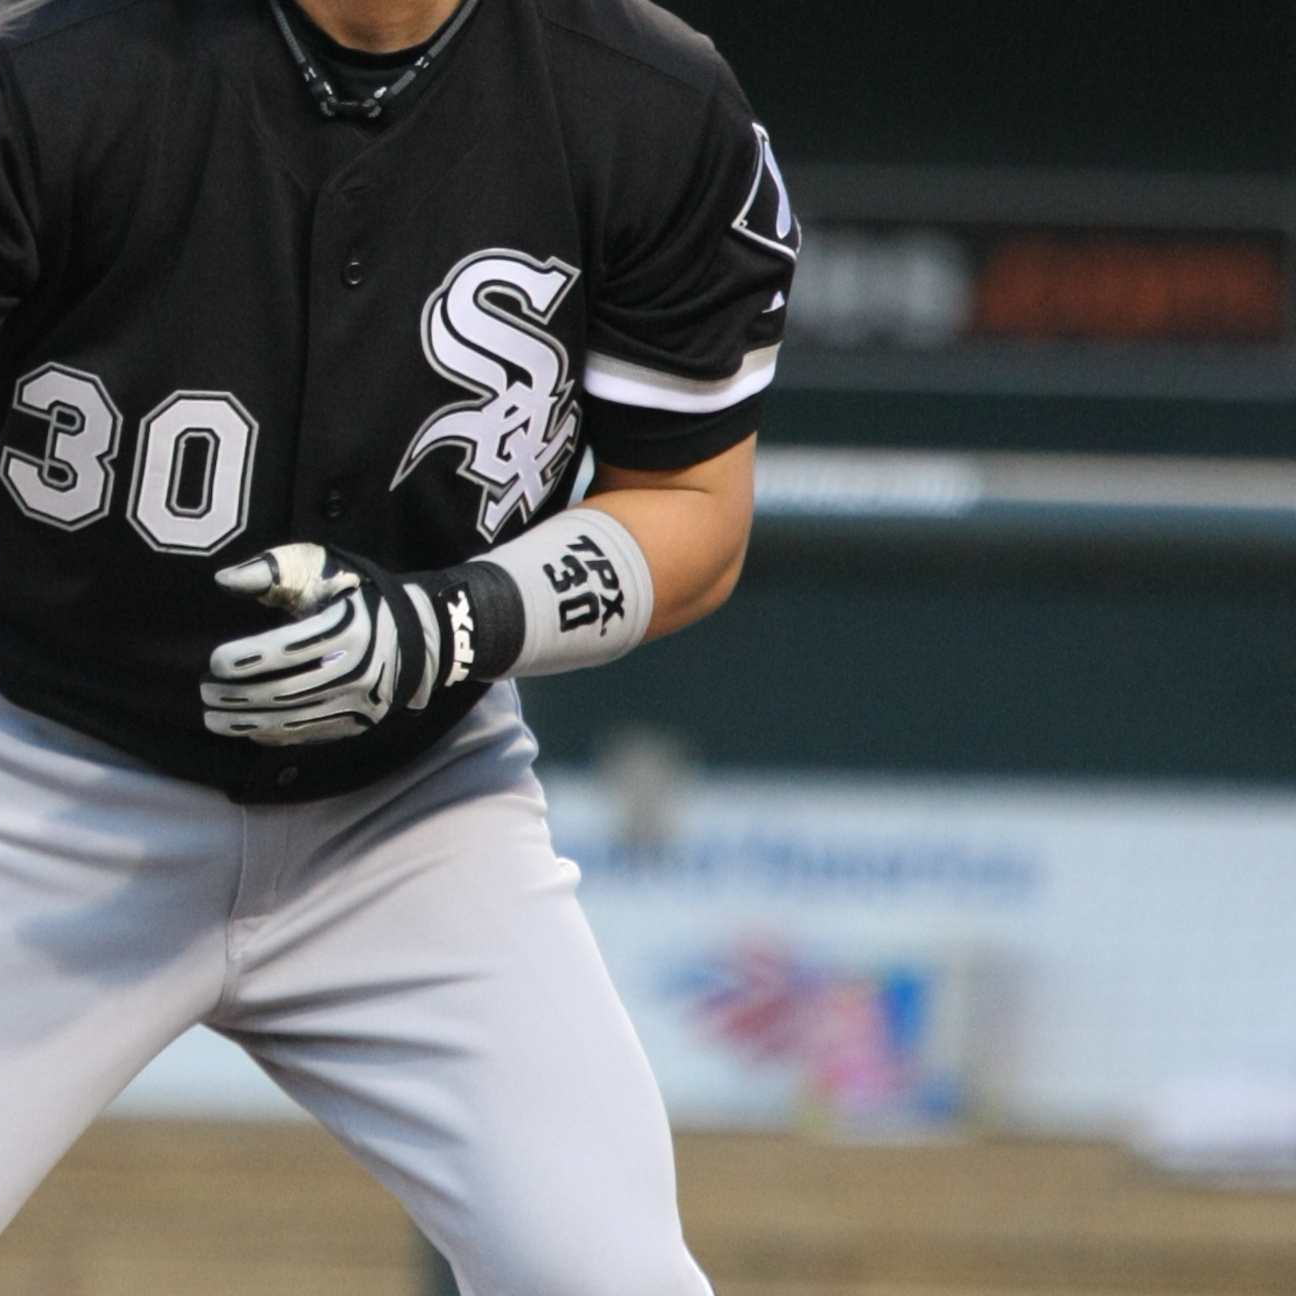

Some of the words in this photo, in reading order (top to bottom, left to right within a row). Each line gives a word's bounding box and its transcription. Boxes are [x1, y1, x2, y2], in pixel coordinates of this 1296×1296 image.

[0, 361, 260, 557] 30
[542, 554, 601, 633] 30
[565, 534, 626, 638] TPX
[445, 590, 475, 687] TPX
